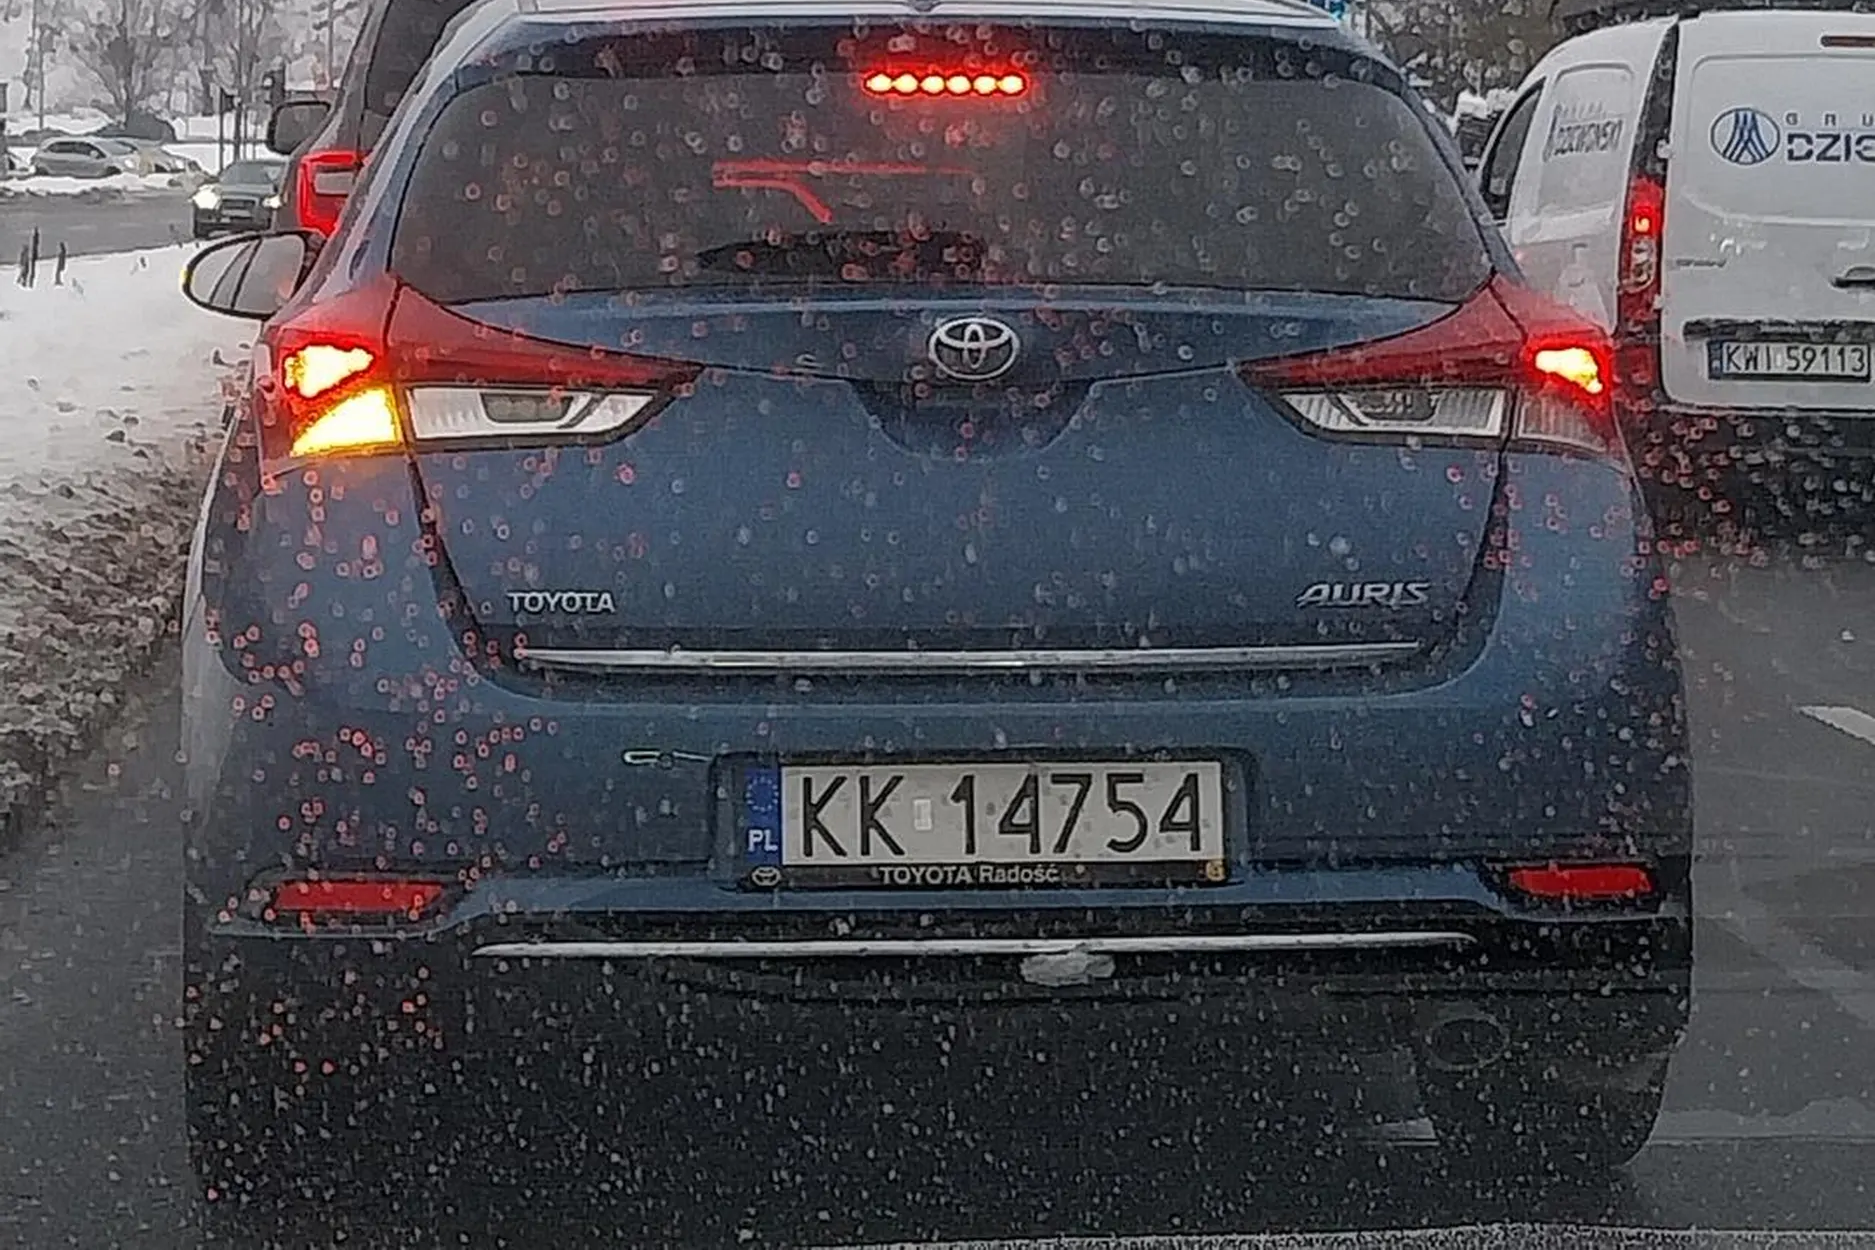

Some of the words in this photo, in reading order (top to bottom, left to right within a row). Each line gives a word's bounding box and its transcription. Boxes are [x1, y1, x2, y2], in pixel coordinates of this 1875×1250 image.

[1726, 345, 1772, 372] KWI
[1786, 346, 1866, 373] 59113
[507, 591, 616, 613] TOYOTA
[1296, 582, 1431, 607] AURIS
[803, 774, 905, 857] KK
[950, 772, 1203, 854] 14754
[748, 829, 779, 852] PL
[880, 866, 974, 885] TOYOTA
[979, 864, 1060, 884] Radość
